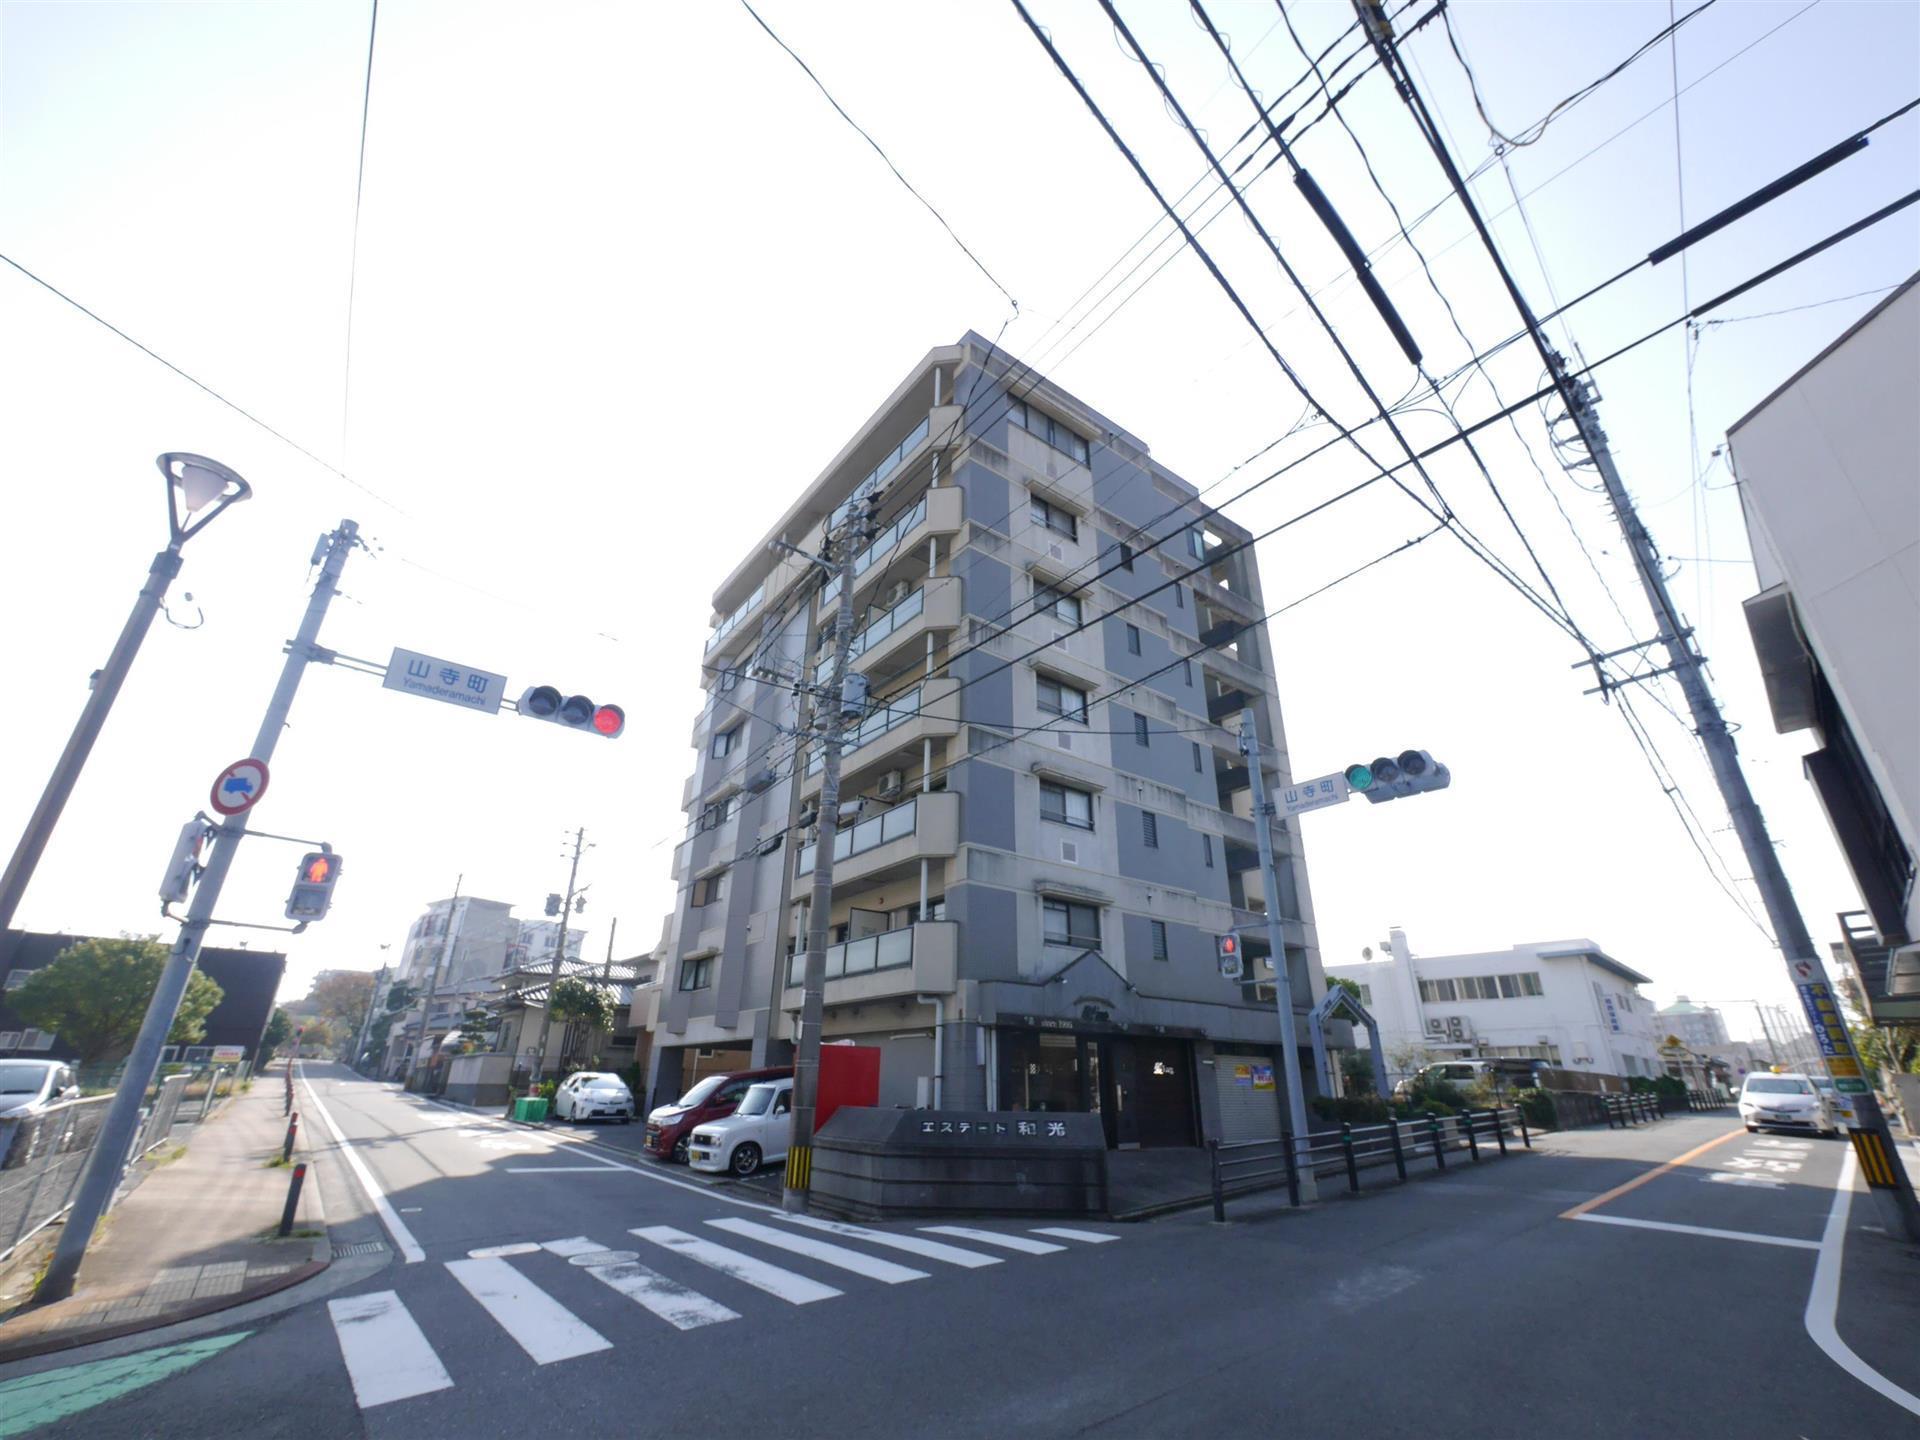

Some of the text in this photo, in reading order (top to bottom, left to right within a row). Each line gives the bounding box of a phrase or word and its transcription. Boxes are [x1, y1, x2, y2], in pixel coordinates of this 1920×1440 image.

[403, 676, 487, 705] Yamaderamachi
[407, 659, 490, 694] 山寺町
[1284, 779, 1334, 803] 山寺町
